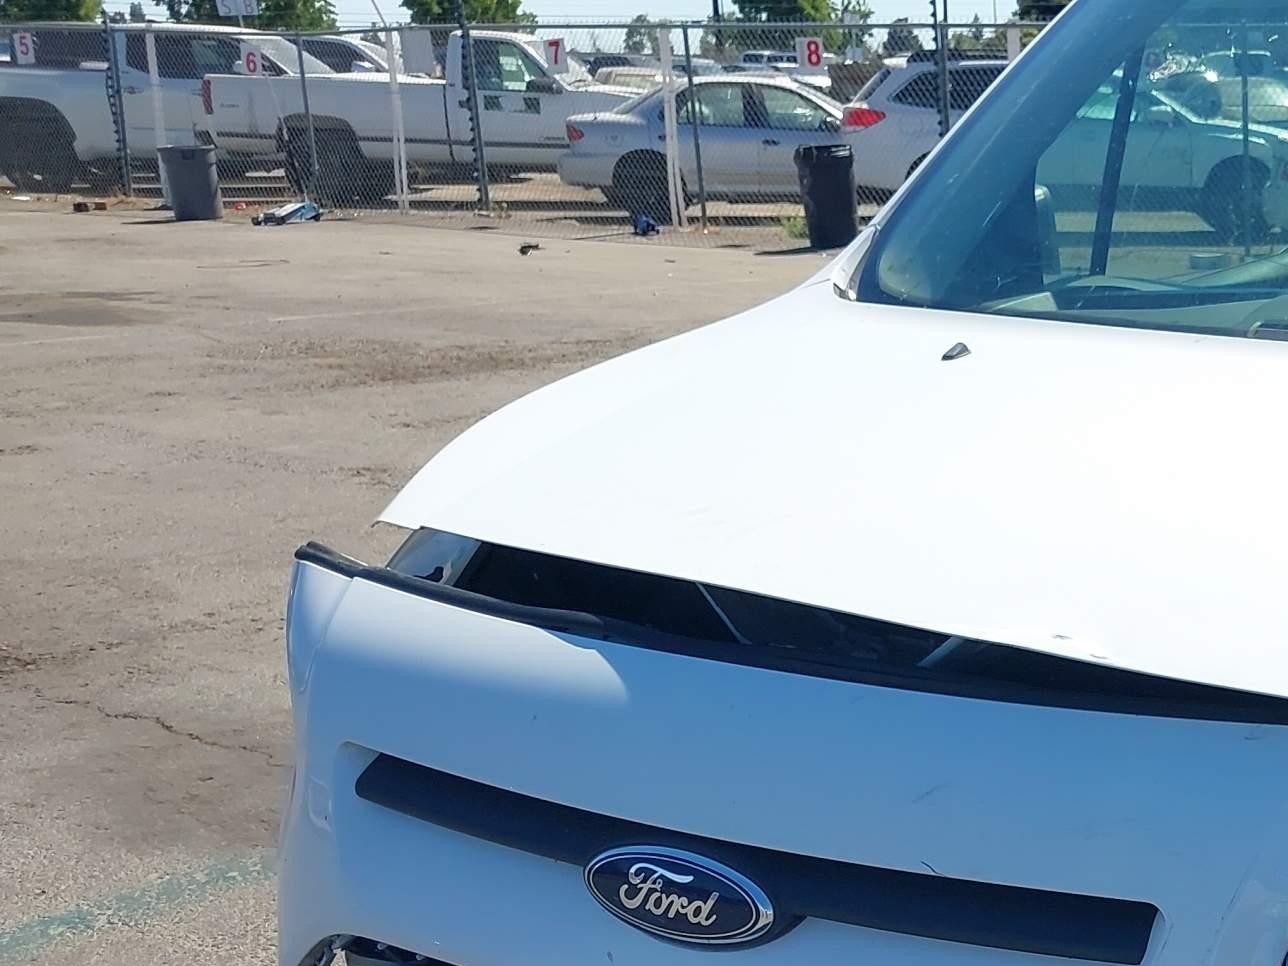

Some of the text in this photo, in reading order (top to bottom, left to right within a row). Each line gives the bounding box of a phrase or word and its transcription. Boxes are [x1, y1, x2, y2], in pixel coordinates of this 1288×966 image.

[19, 32, 30, 56] 5
[548, 40, 560, 65] 7
[806, 40, 821, 66] 8
[246, 51, 257, 73] 6
[619, 862, 720, 927] Ford
